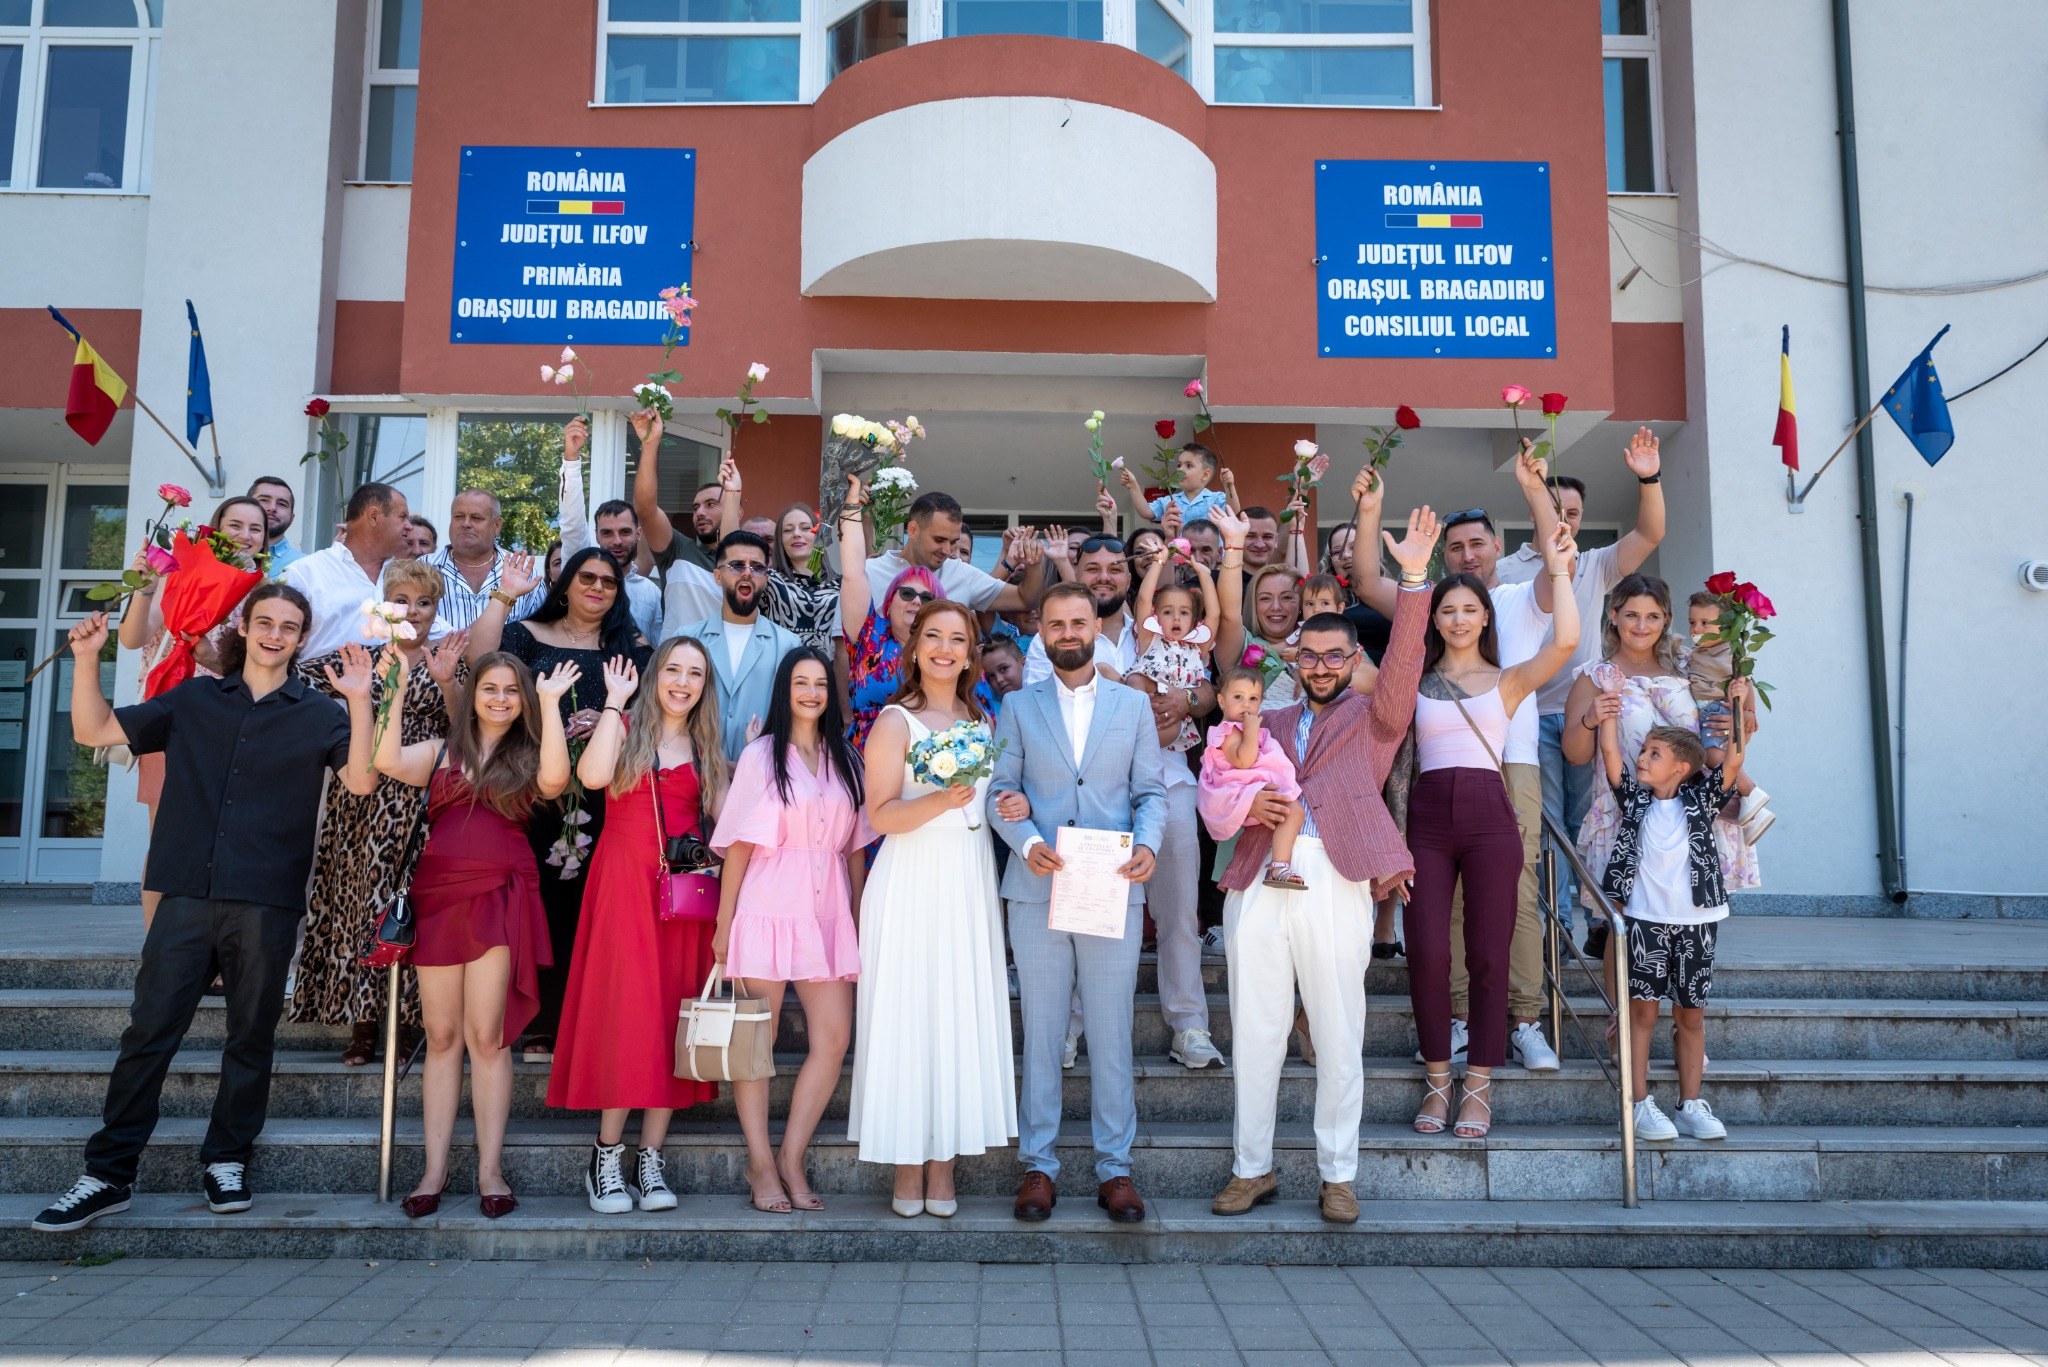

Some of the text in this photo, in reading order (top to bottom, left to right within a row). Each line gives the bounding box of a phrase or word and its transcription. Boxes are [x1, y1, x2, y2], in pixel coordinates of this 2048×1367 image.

[527, 168, 626, 193] ROMÂNIA
[1383, 182, 1483, 206] ROMÂNIA
[500, 224, 648, 249] JUDEȚUL ILFOV
[1357, 244, 1513, 271] JUDEȚUL ILFOV
[522, 262, 623, 286] PRIMĂRIA
[1327, 279, 1545, 306] ORAȘUL BRAGADIRU
[457, 298, 676, 324] ORAȘULUI BRAGADIR
[1344, 315, 1530, 337] CONSILIUL LOCAL
